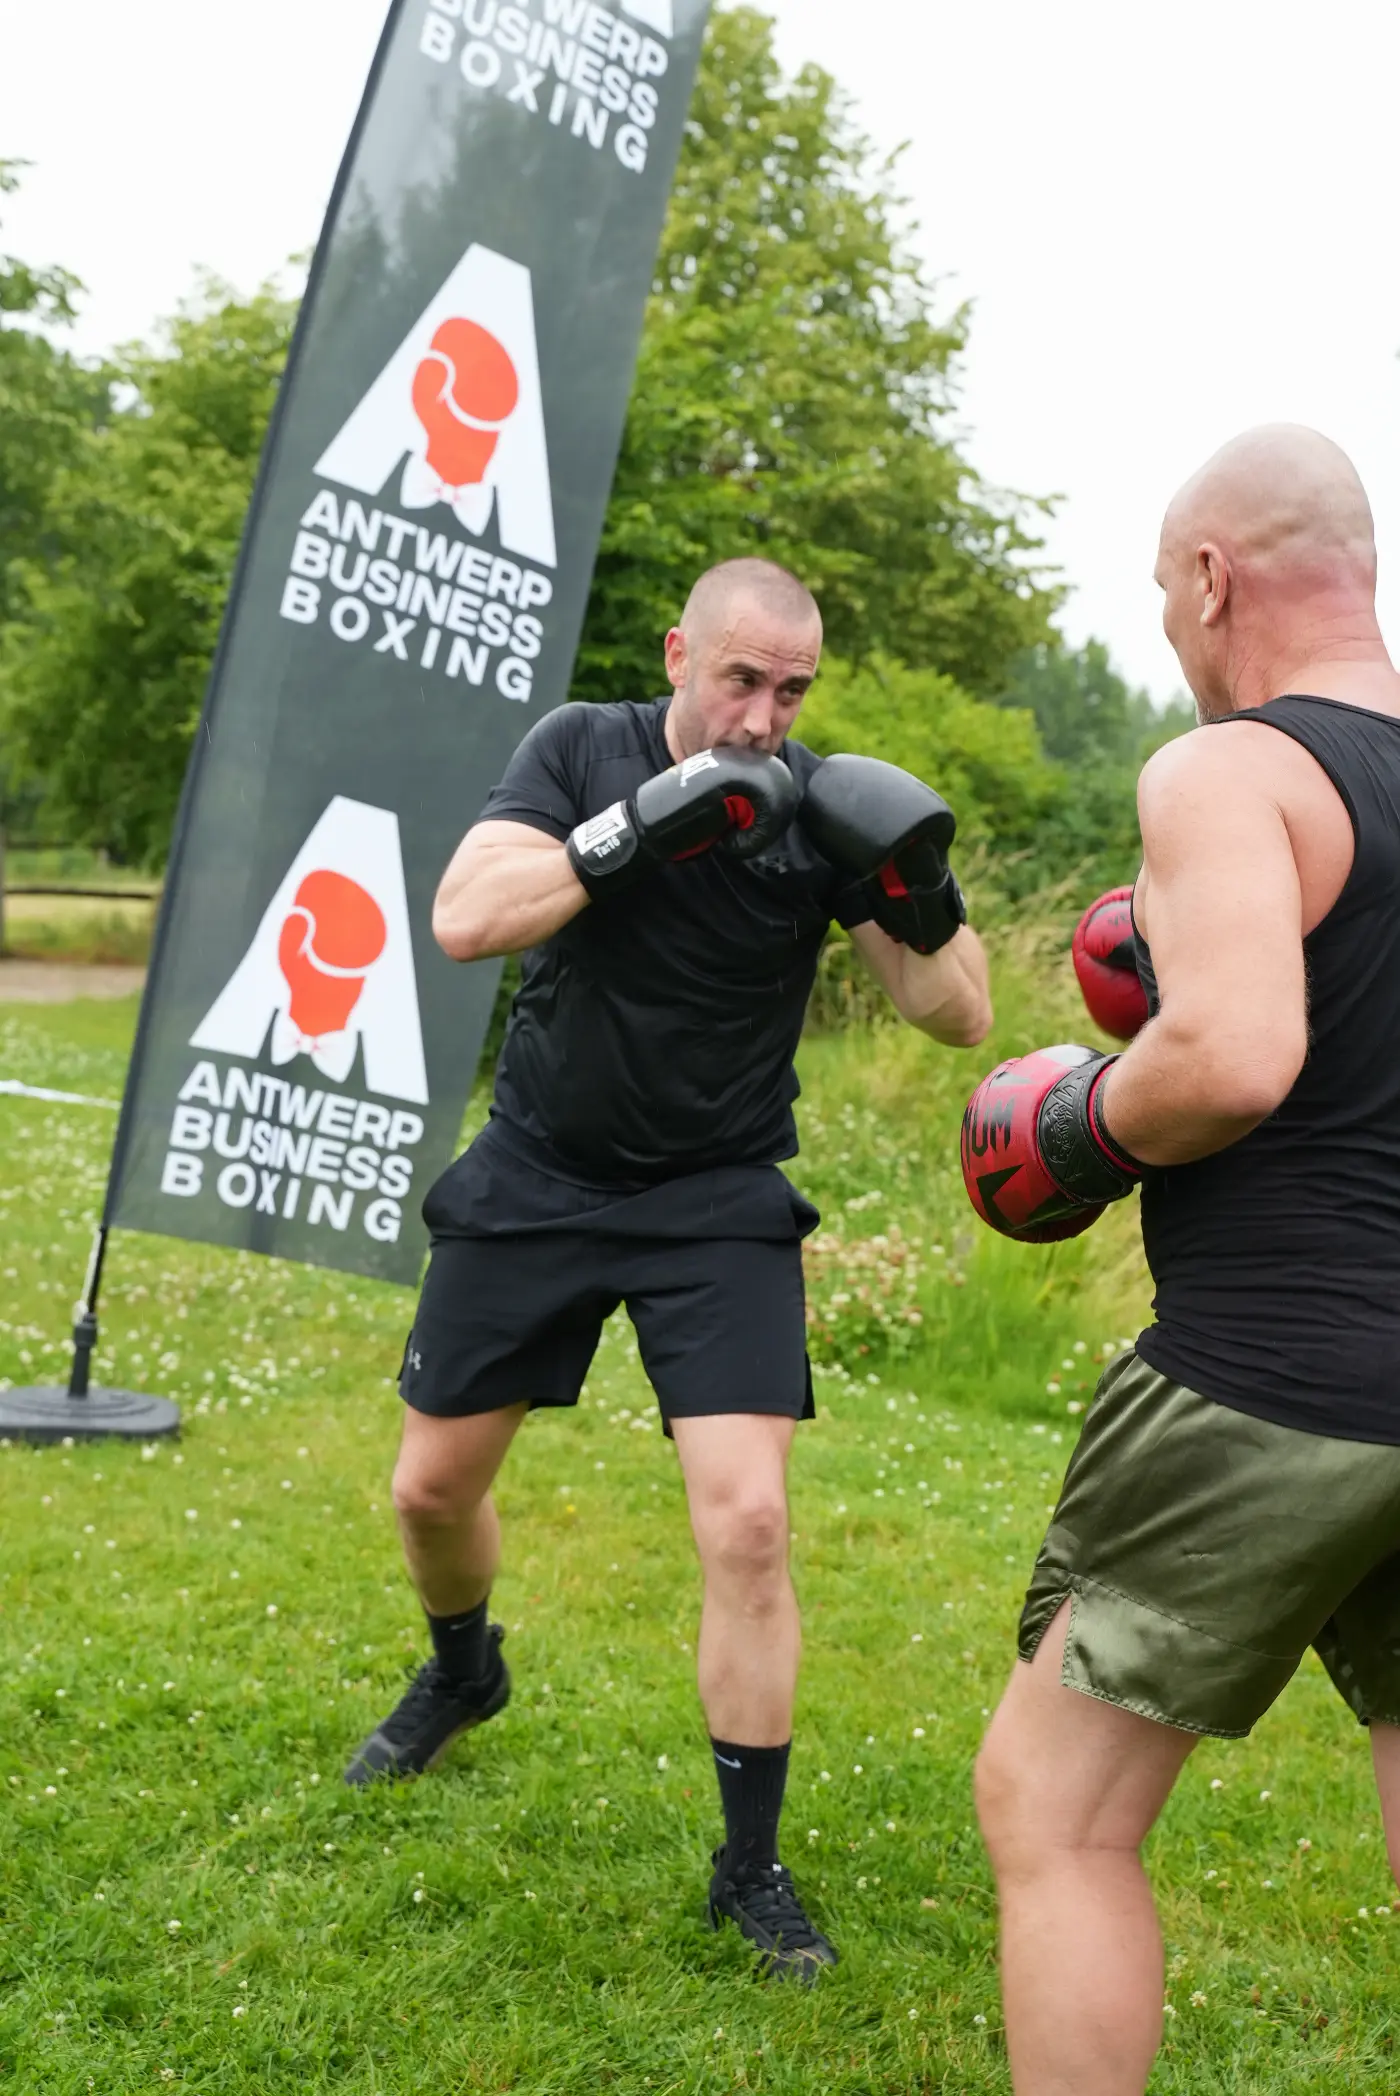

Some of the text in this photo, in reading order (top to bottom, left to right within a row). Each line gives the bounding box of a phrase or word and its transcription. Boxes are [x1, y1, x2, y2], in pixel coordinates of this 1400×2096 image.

[420, 11, 648, 173] BOXING
[516, 0, 668, 77] WERP
[290, 530, 543, 659] BUSINESS
[300, 489, 553, 610] ANTWERP
[279, 575, 533, 703] BOXING
[169, 1104, 413, 1198] BUSINESS
[177, 1060, 424, 1150] ANTWERP
[160, 1151, 402, 1242] BOXING
